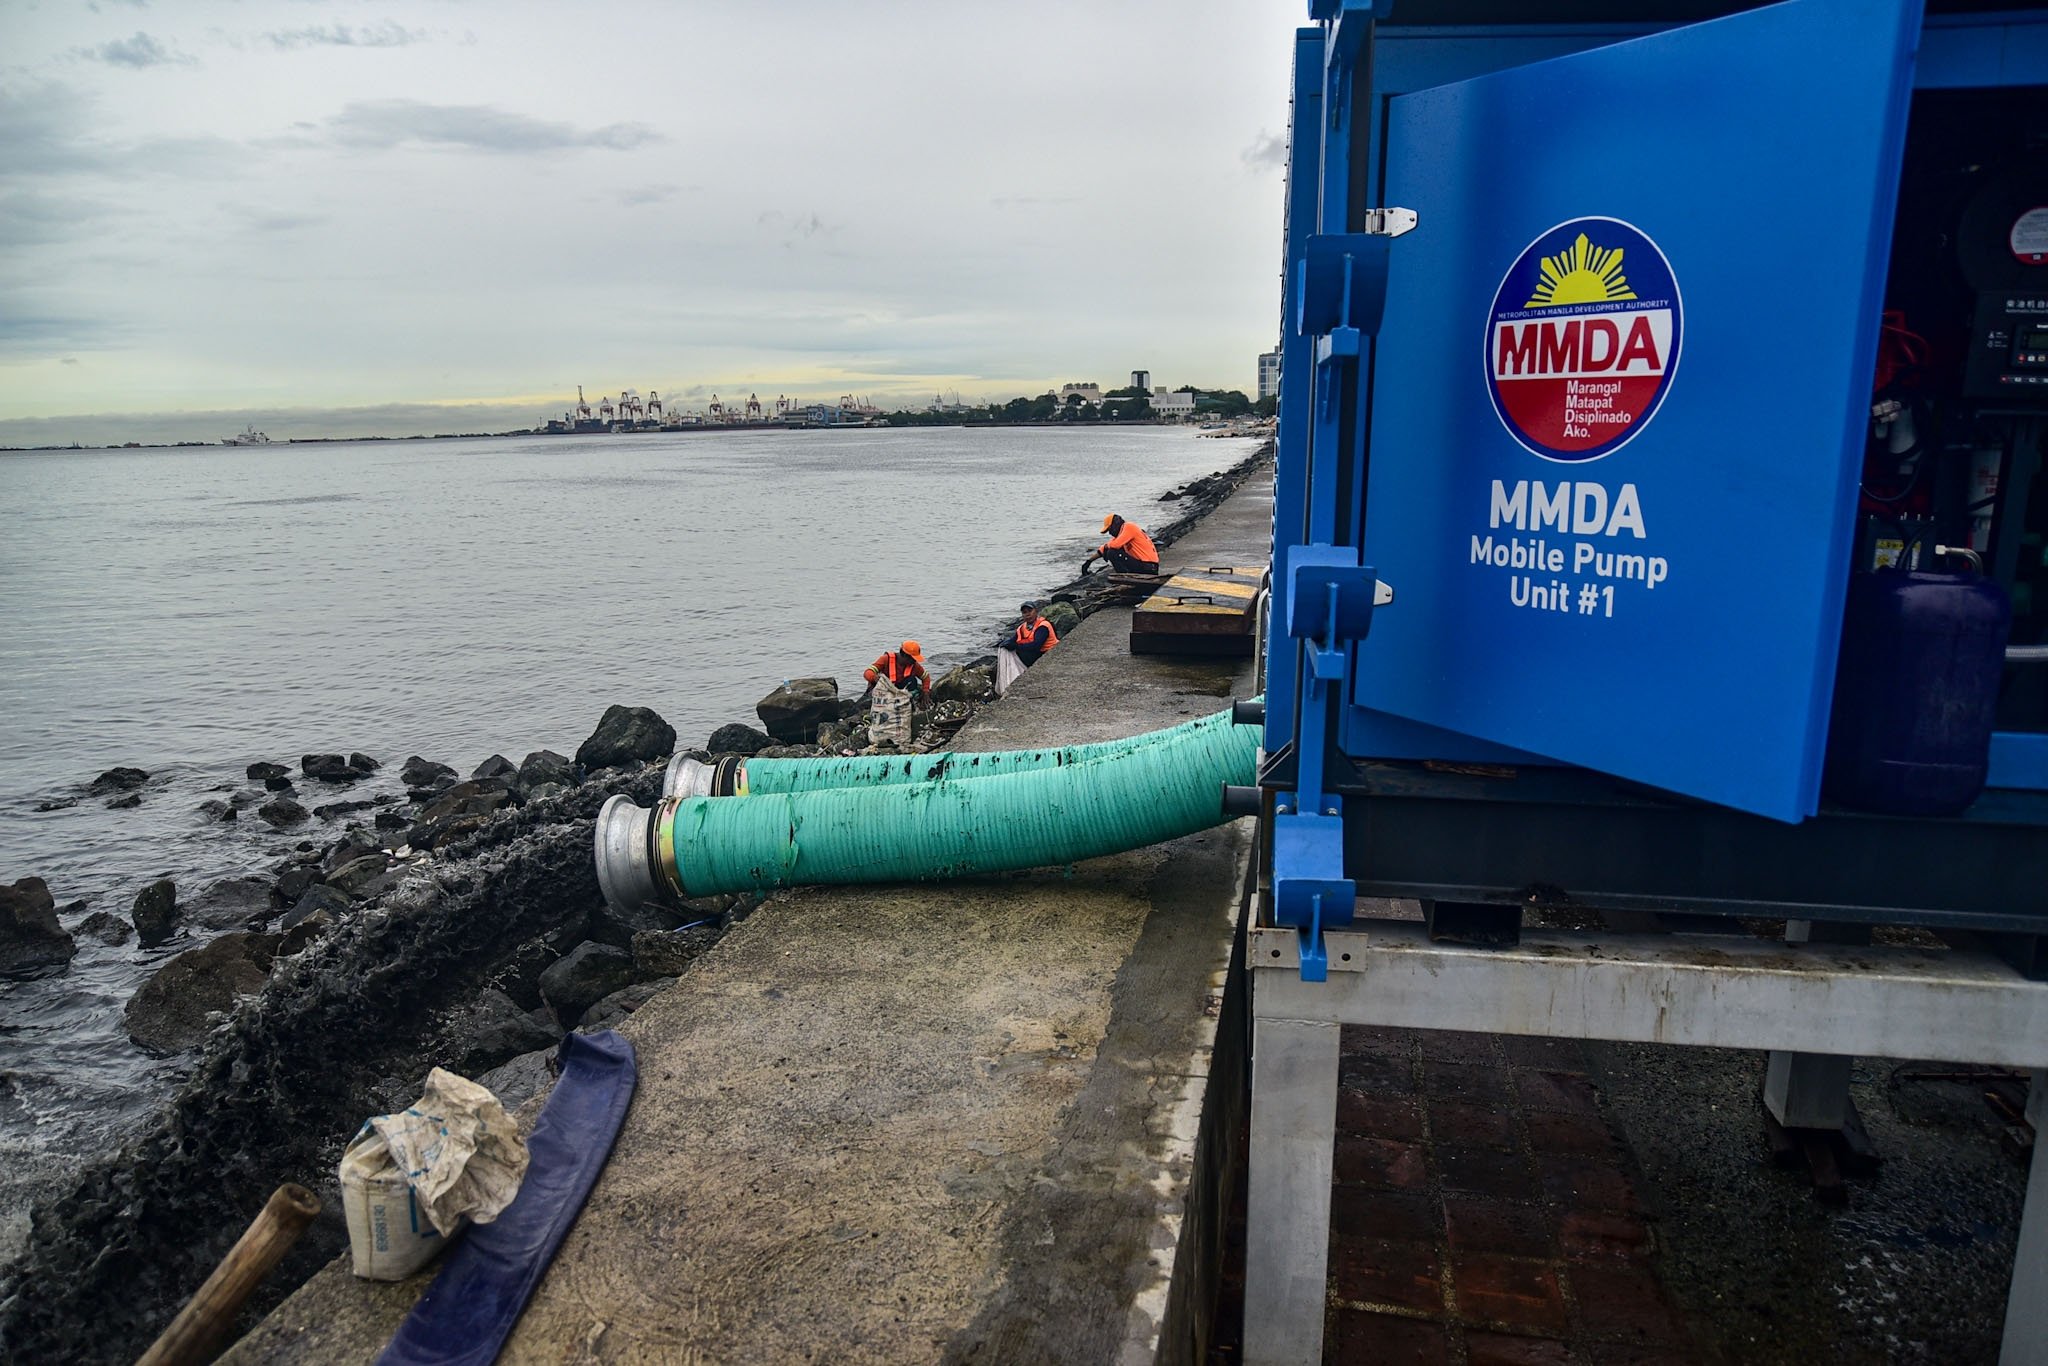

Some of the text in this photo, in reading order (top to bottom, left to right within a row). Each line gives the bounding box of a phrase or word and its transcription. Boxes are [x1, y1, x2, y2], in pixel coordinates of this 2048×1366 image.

[1498, 300, 1669, 319] METROPOLITAN MANILA DEVELOPMENT AUTHORITY
[1498, 316, 1661, 375] MMDA
[1566, 380, 1621, 397] Marangal
[1565, 395, 1613, 411] Matapat
[1565, 409, 1632, 426] Disiplinado
[1563, 423, 1591, 437] Ako.
[1490, 479, 1646, 538] MMDA
[1470, 535, 1668, 589] Mobile Pump
[1511, 576, 1614, 618] Unit #1
